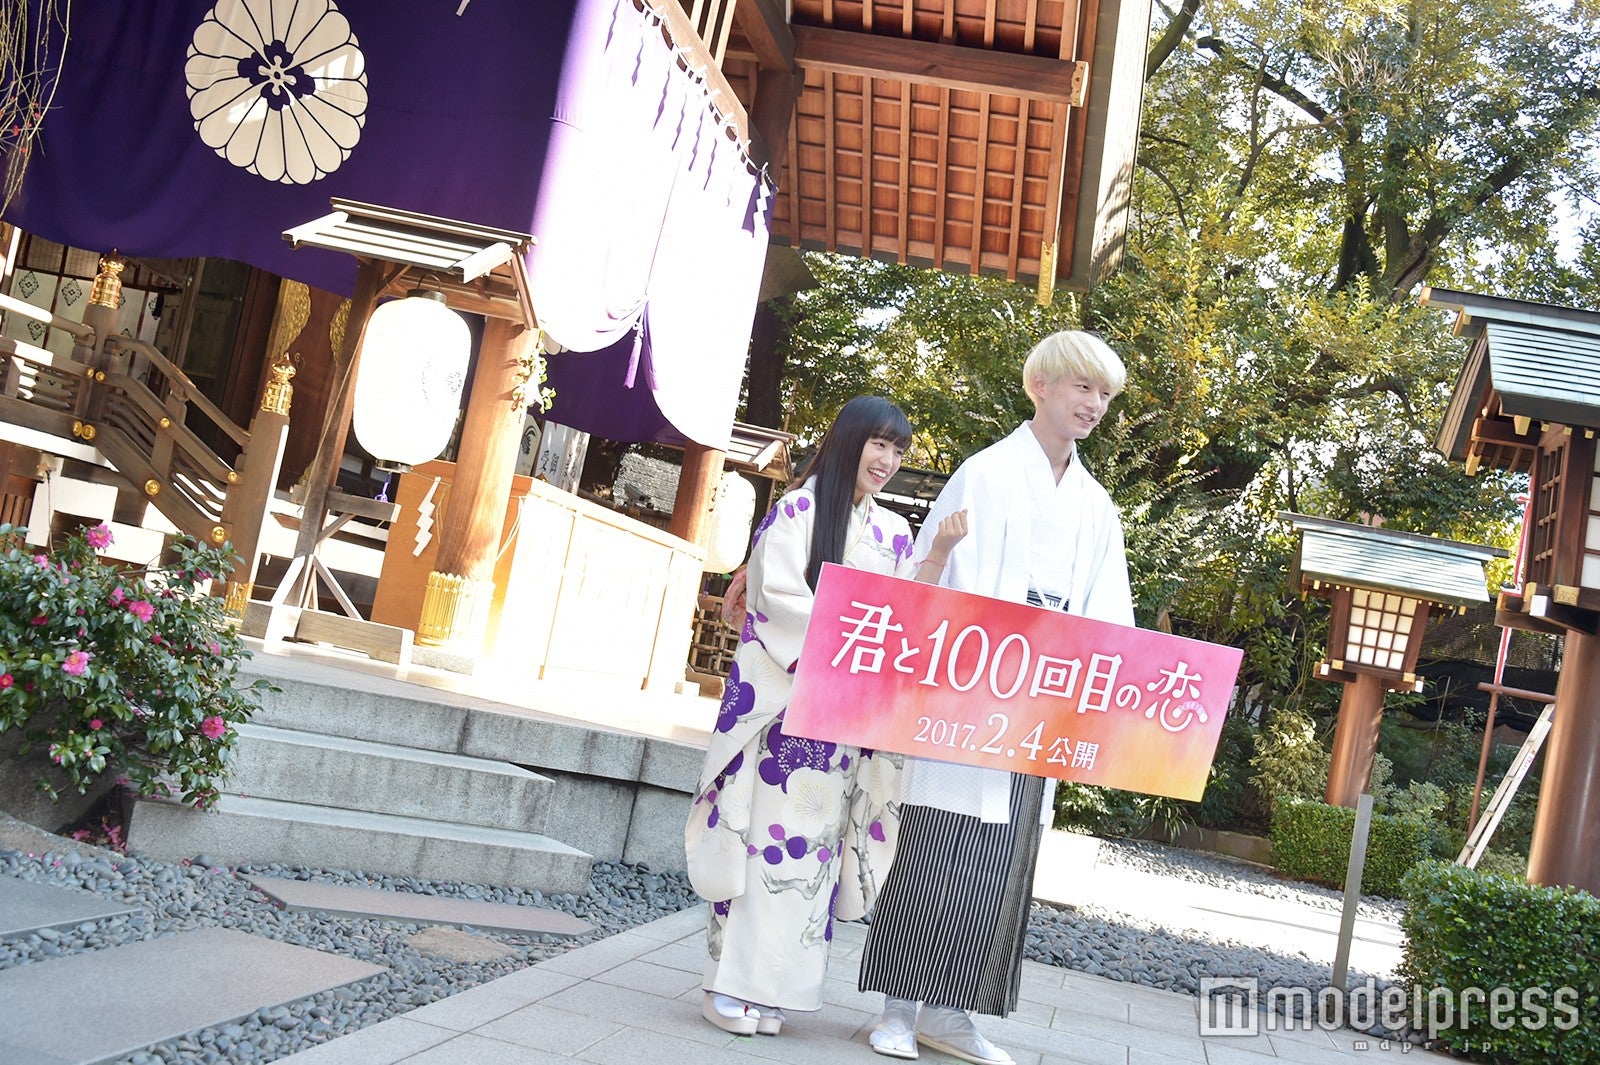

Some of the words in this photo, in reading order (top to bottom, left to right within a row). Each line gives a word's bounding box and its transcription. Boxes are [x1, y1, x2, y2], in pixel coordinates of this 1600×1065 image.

[831, 601, 1208, 733] 君と100回目の恋
